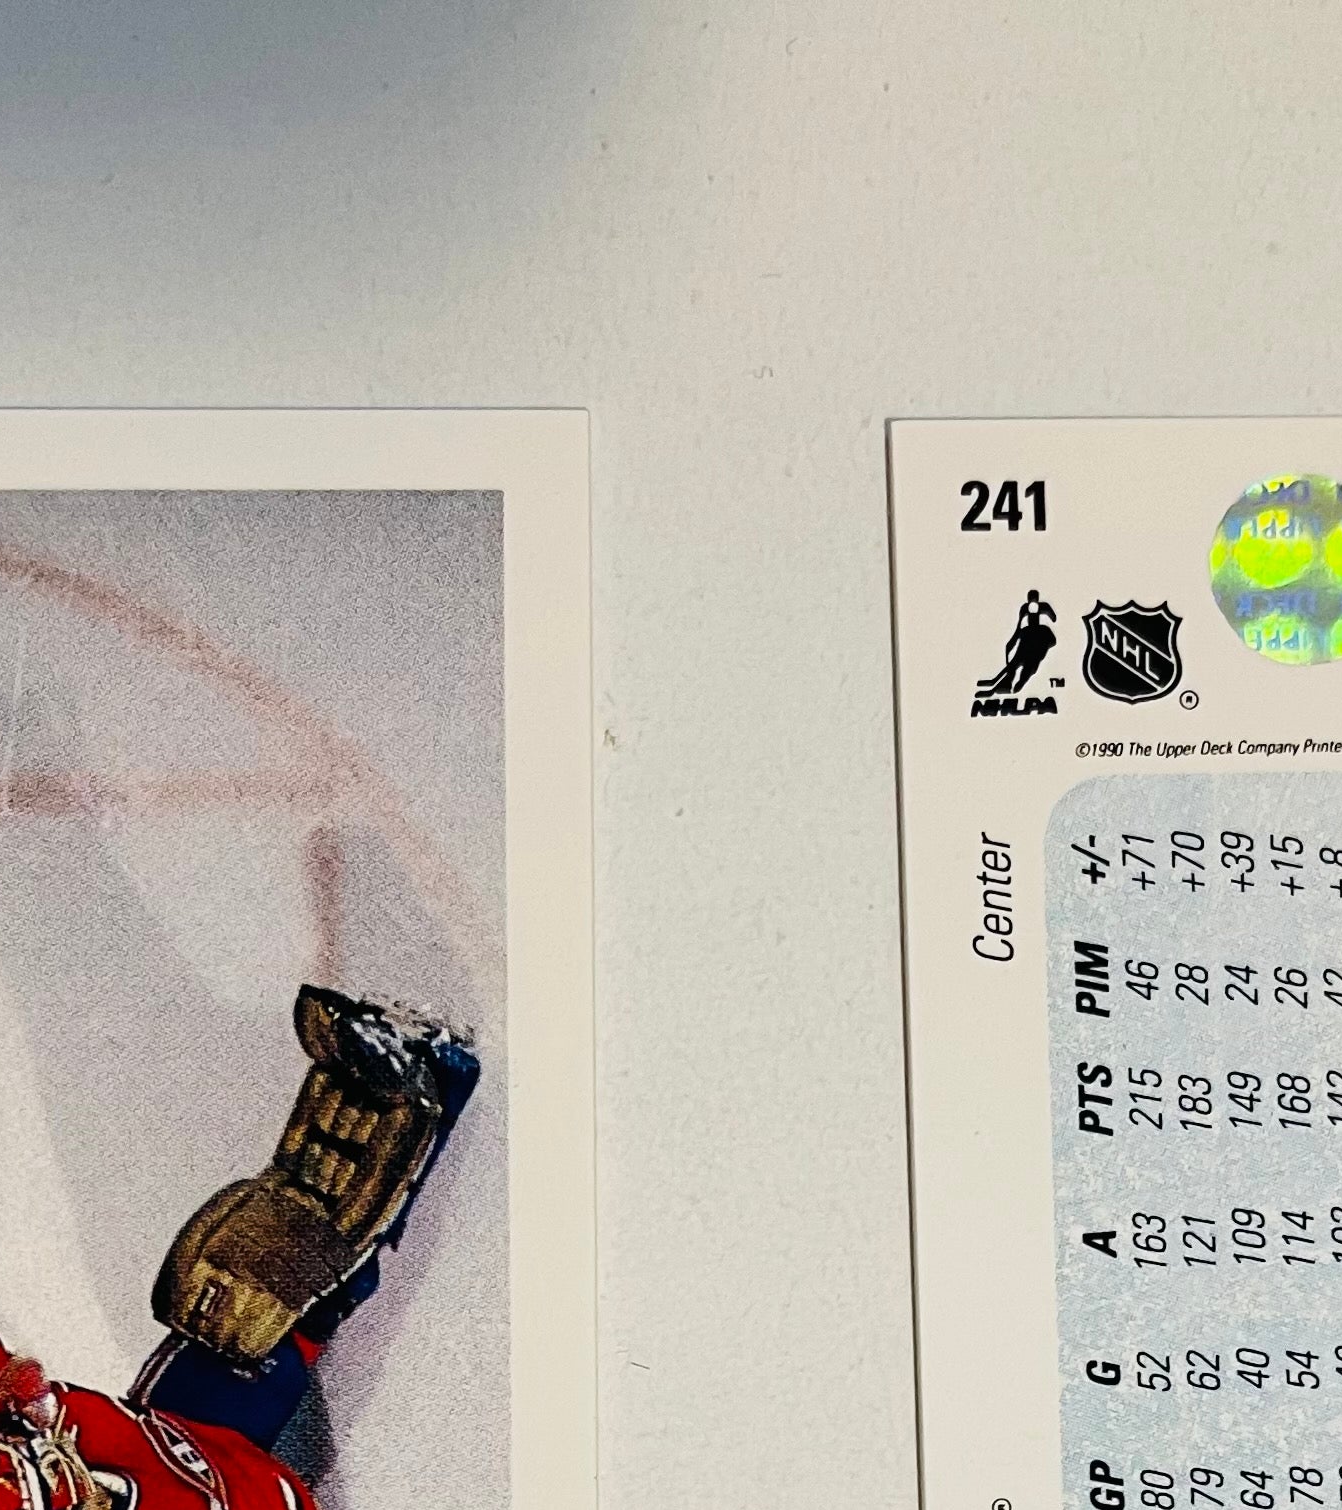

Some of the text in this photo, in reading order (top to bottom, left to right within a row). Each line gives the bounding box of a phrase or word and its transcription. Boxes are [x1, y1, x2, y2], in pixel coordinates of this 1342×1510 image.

[961, 481, 1046, 531] 241
[1101, 620, 1161, 681] NHL
[971, 696, 1057, 717] NHLPA
[1129, 742, 1151, 756] The
[1156, 742, 1196, 759] Upper
[1201, 740, 1233, 755] Deck
[1238, 740, 1300, 757] Company
[1071, 835, 1110, 884] +/-
[1122, 835, 1155, 890] +71
[1221, 831, 1254, 892] +39
[973, 832, 1014, 961] Center
[1074, 941, 1110, 1017] PIM
[1125, 960, 1158, 1000] 46
[1224, 965, 1258, 1005] 24
[1077, 1062, 1113, 1136] PTS
[1128, 1068, 1162, 1129] 215
[1227, 1072, 1262, 1127] 149
[1083, 1231, 1117, 1258] A
[1132, 1213, 1167, 1268] 163
[1232, 1208, 1266, 1263] 109
[1086, 1360, 1121, 1385] G
[1137, 1352, 1171, 1391] 52
[1236, 1348, 1269, 1388] 40
[1140, 1470, 1174, 1510] 80
[1240, 1471, 1274, 1509] 64
